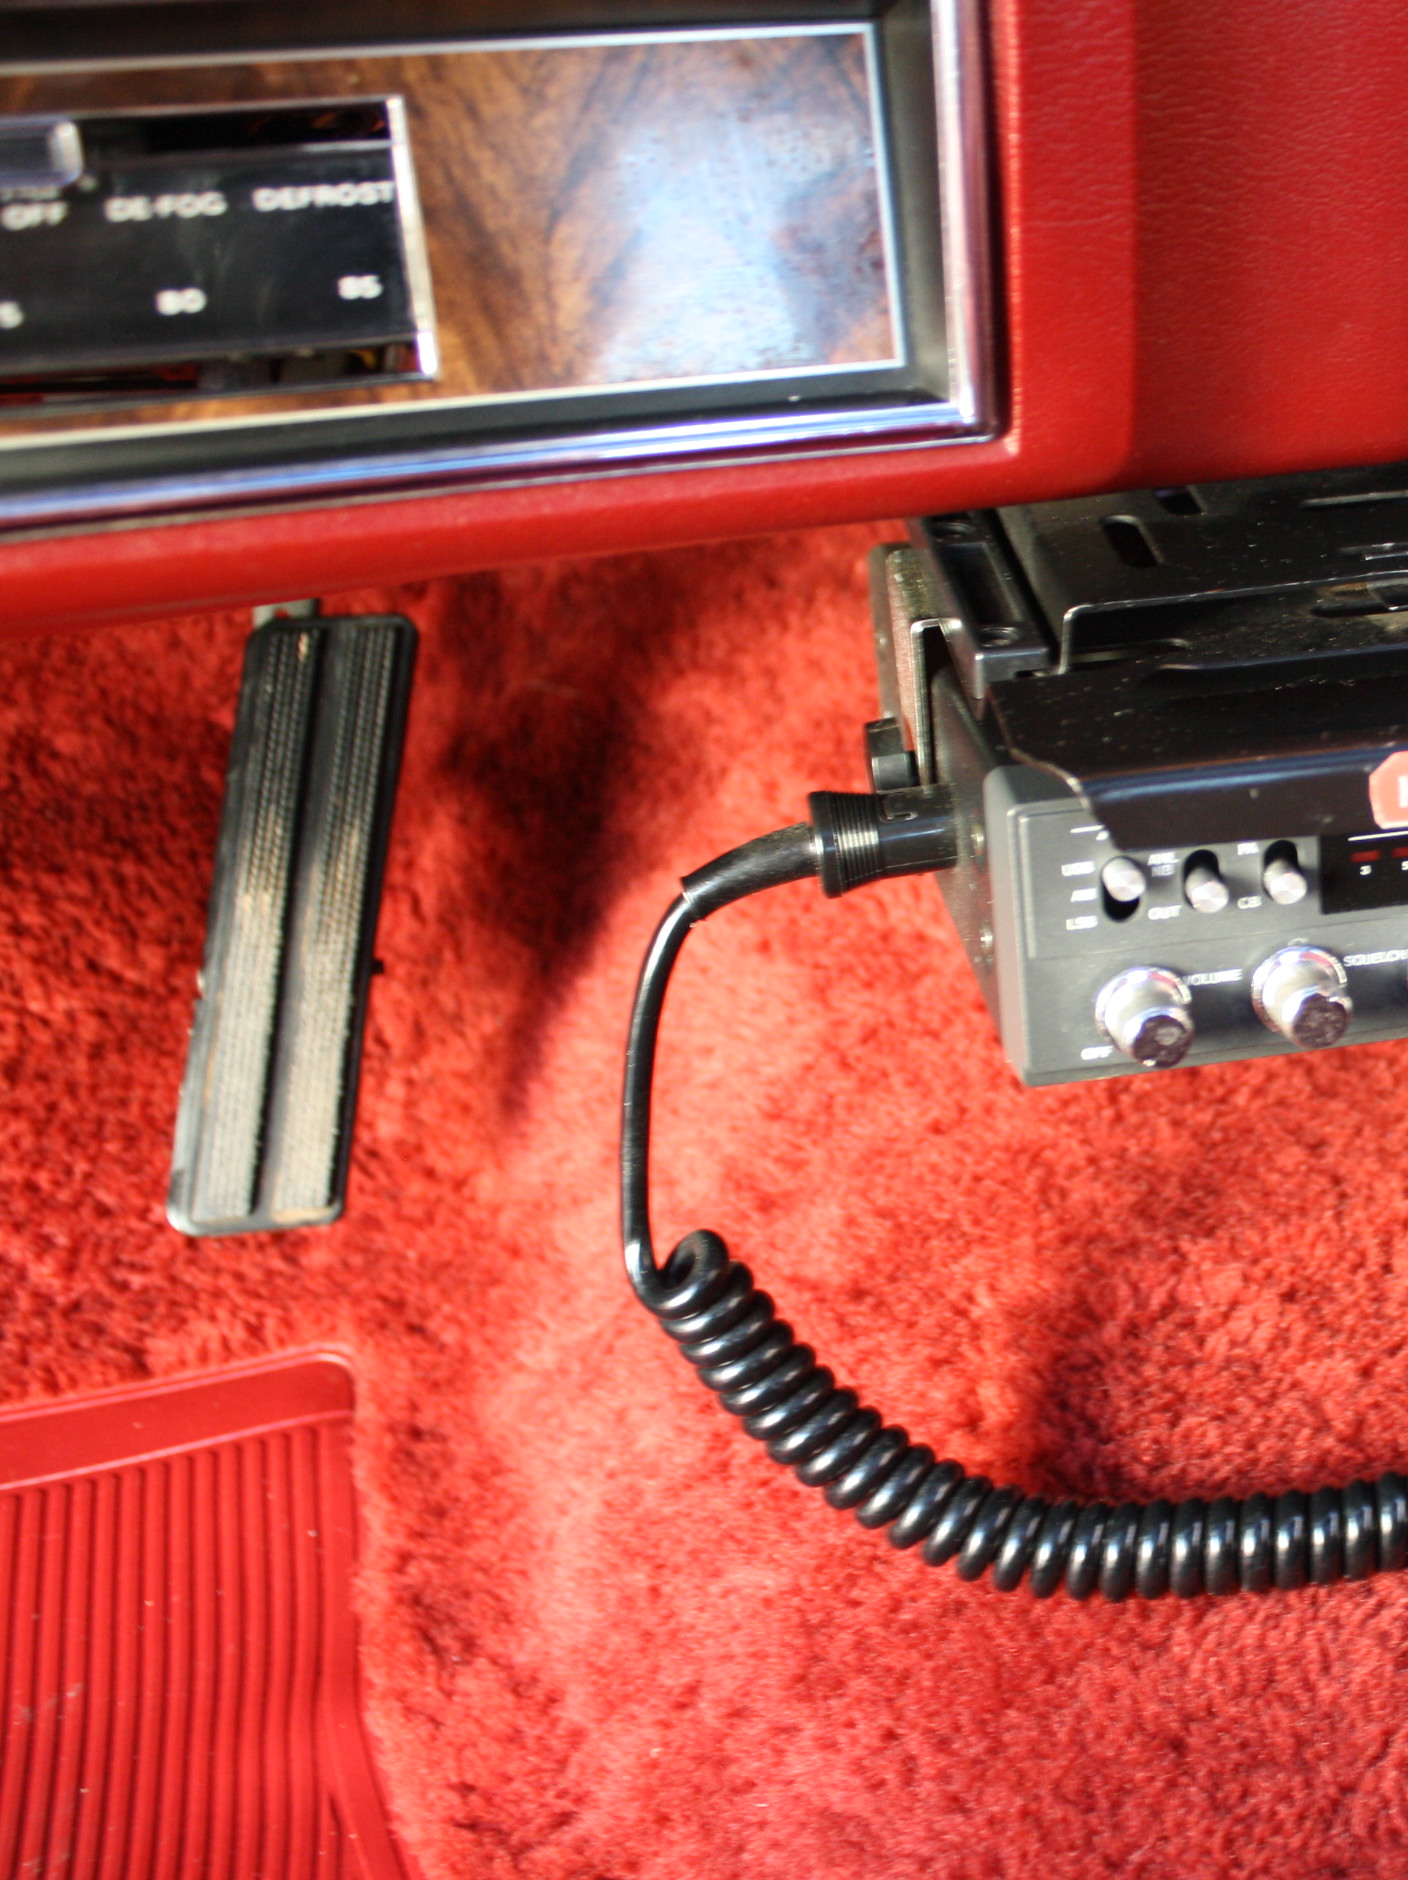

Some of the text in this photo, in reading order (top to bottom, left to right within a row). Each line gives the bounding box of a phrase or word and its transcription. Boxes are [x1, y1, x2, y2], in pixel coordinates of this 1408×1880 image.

[253, 181, 394, 211] DEFROST
[1148, 904, 1182, 920] OUT
[1343, 949, 1408, 967] SQUELCH
[1183, 968, 1243, 985] VOLUME
